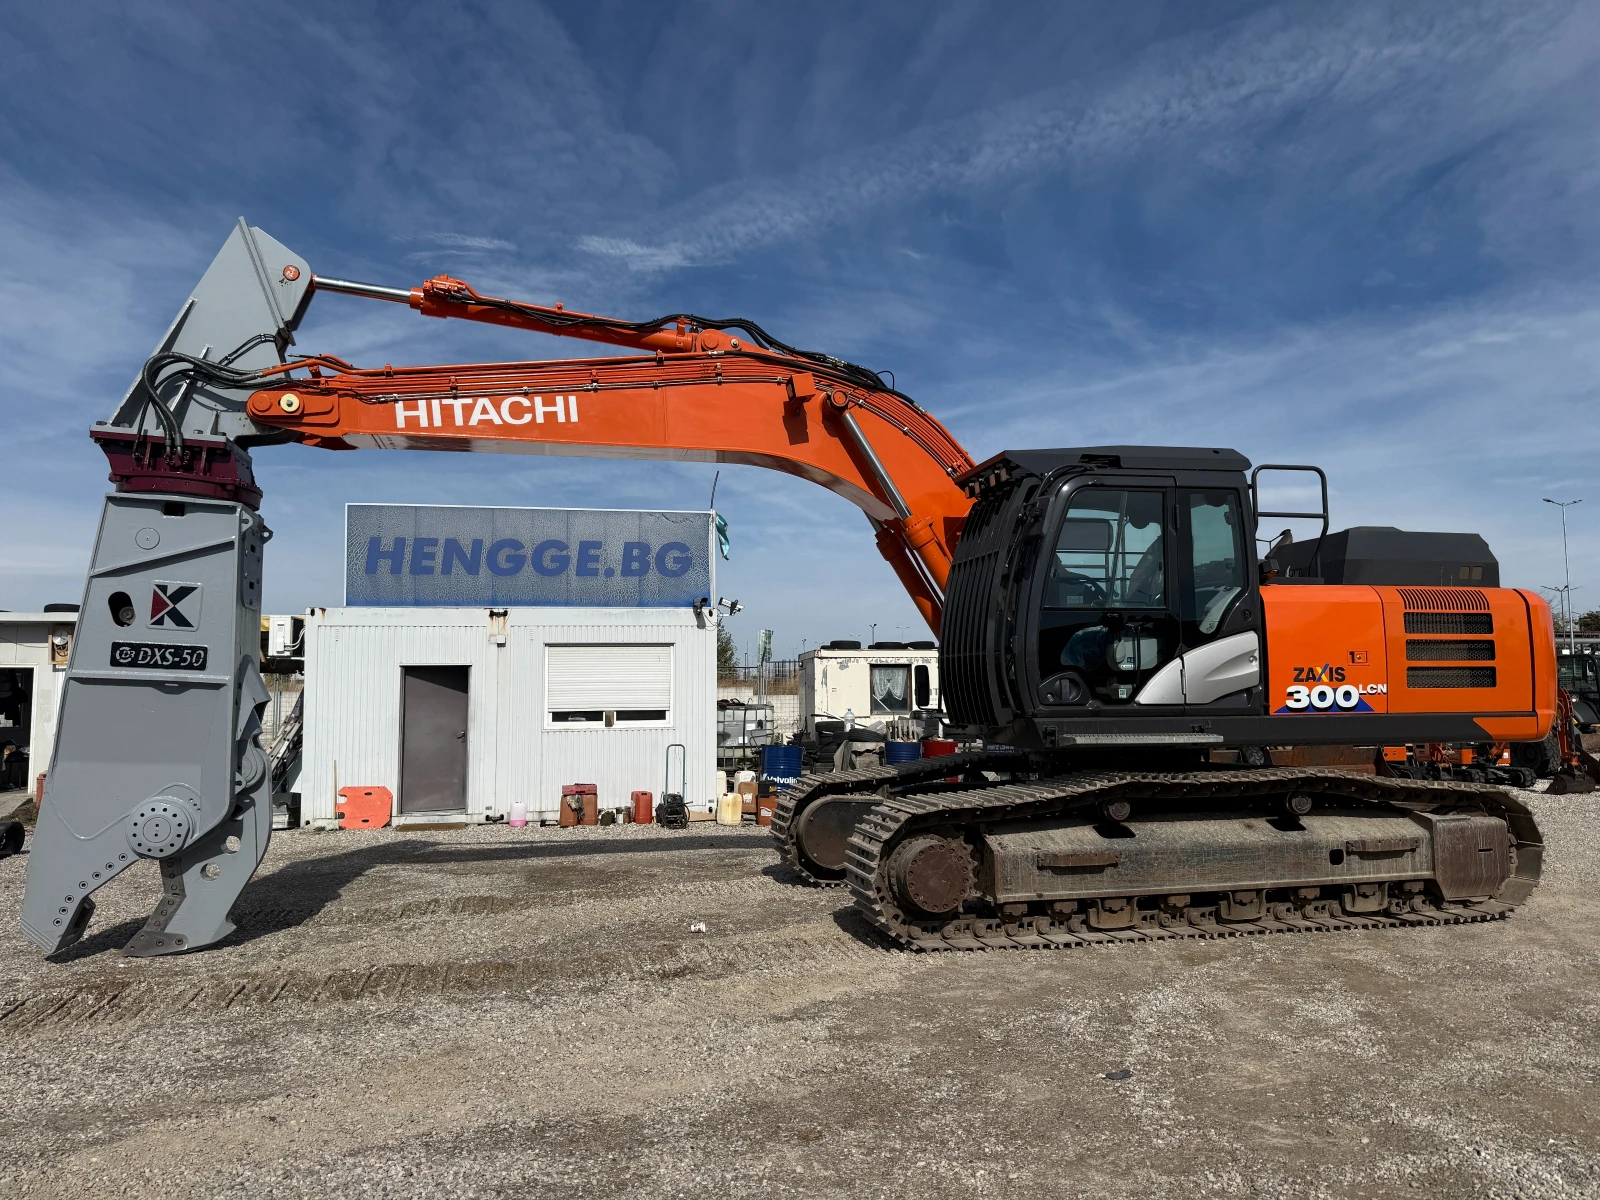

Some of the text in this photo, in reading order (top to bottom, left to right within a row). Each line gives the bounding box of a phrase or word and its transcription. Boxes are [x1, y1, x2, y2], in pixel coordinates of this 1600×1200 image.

[395, 394, 579, 429] HITACHI
[364, 536, 693, 578] HENGGE.BG
[137, 647, 204, 667] DXS-50
[1293, 662, 1346, 682] ZAXIS
[1285, 684, 1387, 712] 300 LCN
[767, 776, 798, 784] Valvolin
